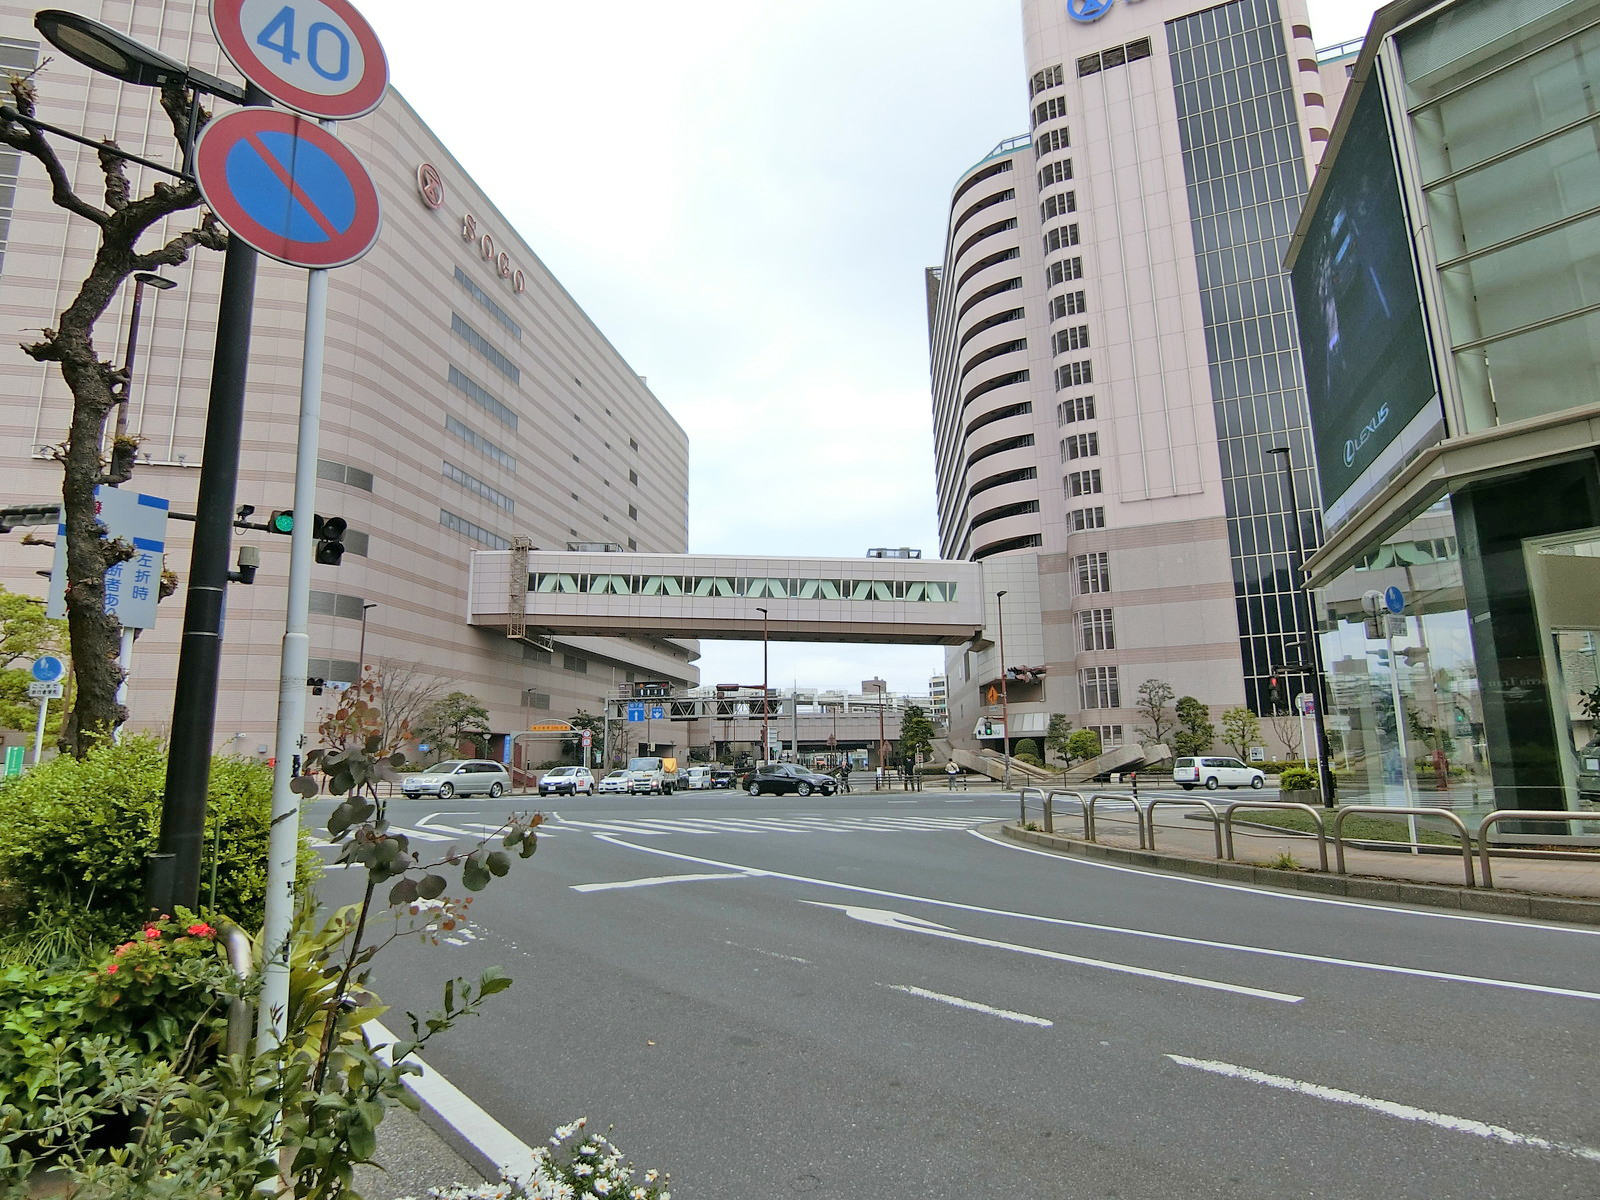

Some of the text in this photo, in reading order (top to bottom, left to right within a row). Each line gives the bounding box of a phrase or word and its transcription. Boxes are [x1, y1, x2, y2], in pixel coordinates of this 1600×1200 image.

[256, 5, 351, 82] 40
[463, 213, 526, 295] SOGO
[1354, 402, 1389, 451] LEXUS
[132, 553, 154, 601] 左折時
